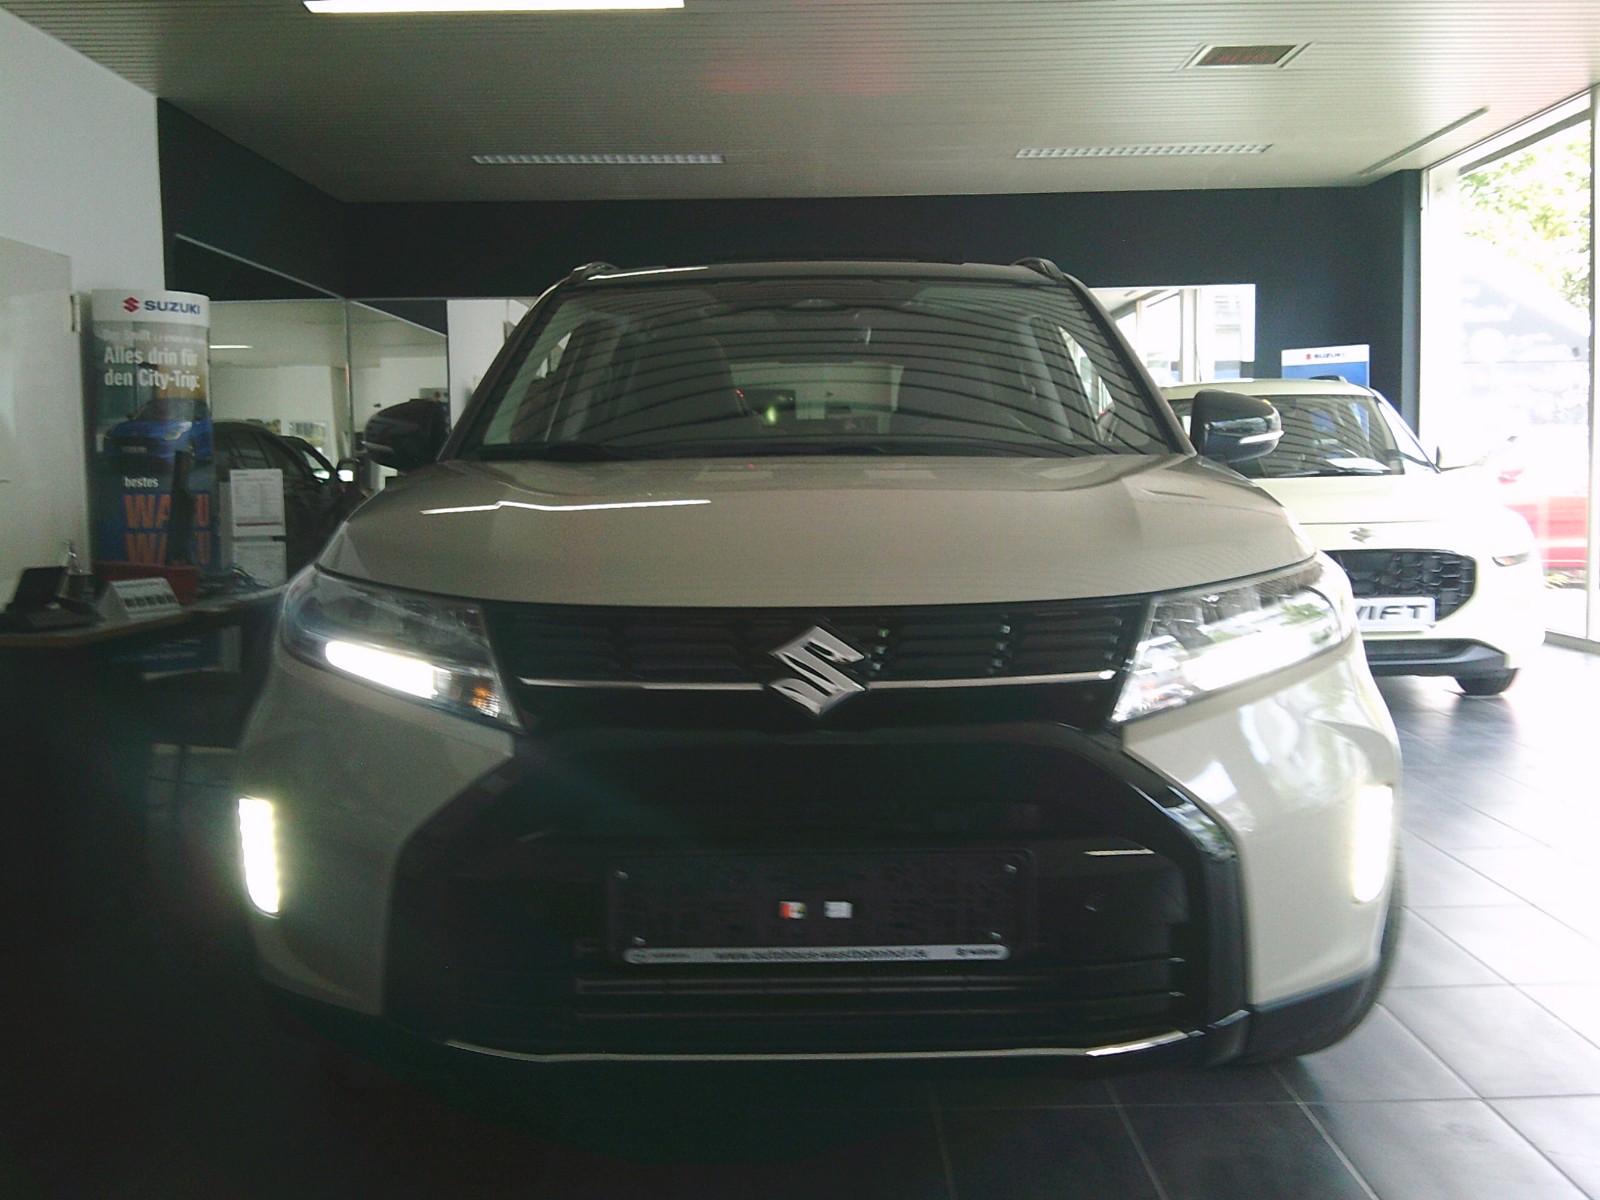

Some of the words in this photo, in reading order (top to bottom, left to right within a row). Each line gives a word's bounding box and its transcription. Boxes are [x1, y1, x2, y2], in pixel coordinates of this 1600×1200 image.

[144, 300, 200, 315] SUZUKI
[104, 346, 144, 365] Alles
[148, 347, 178, 366] drin
[181, 348, 198, 367] für
[104, 369, 133, 386] den
[124, 476, 160, 488] bestes
[1356, 604, 1428, 620] IFT
